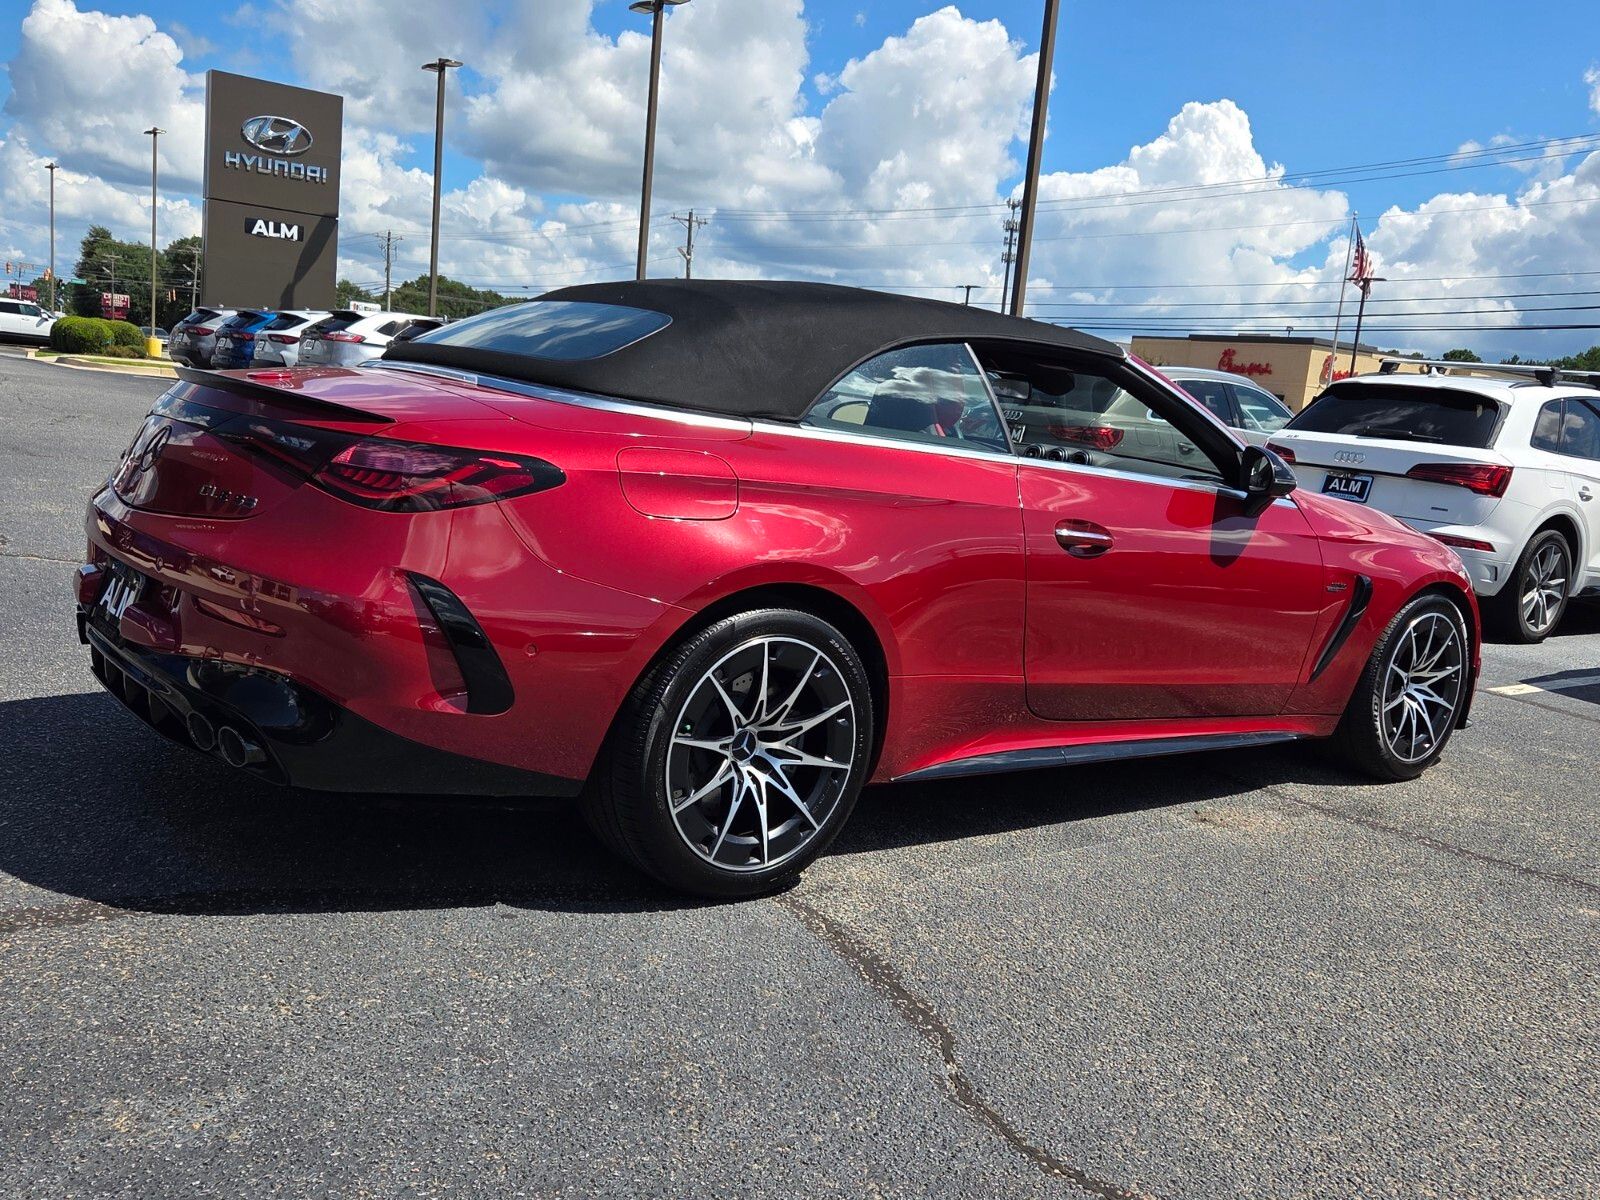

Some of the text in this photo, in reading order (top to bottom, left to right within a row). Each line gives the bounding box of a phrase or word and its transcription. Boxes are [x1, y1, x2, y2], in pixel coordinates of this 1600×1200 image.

[225, 150, 327, 183] HYUNDAI
[251, 219, 299, 242] ALM
[1328, 478, 1362, 494] ALM
